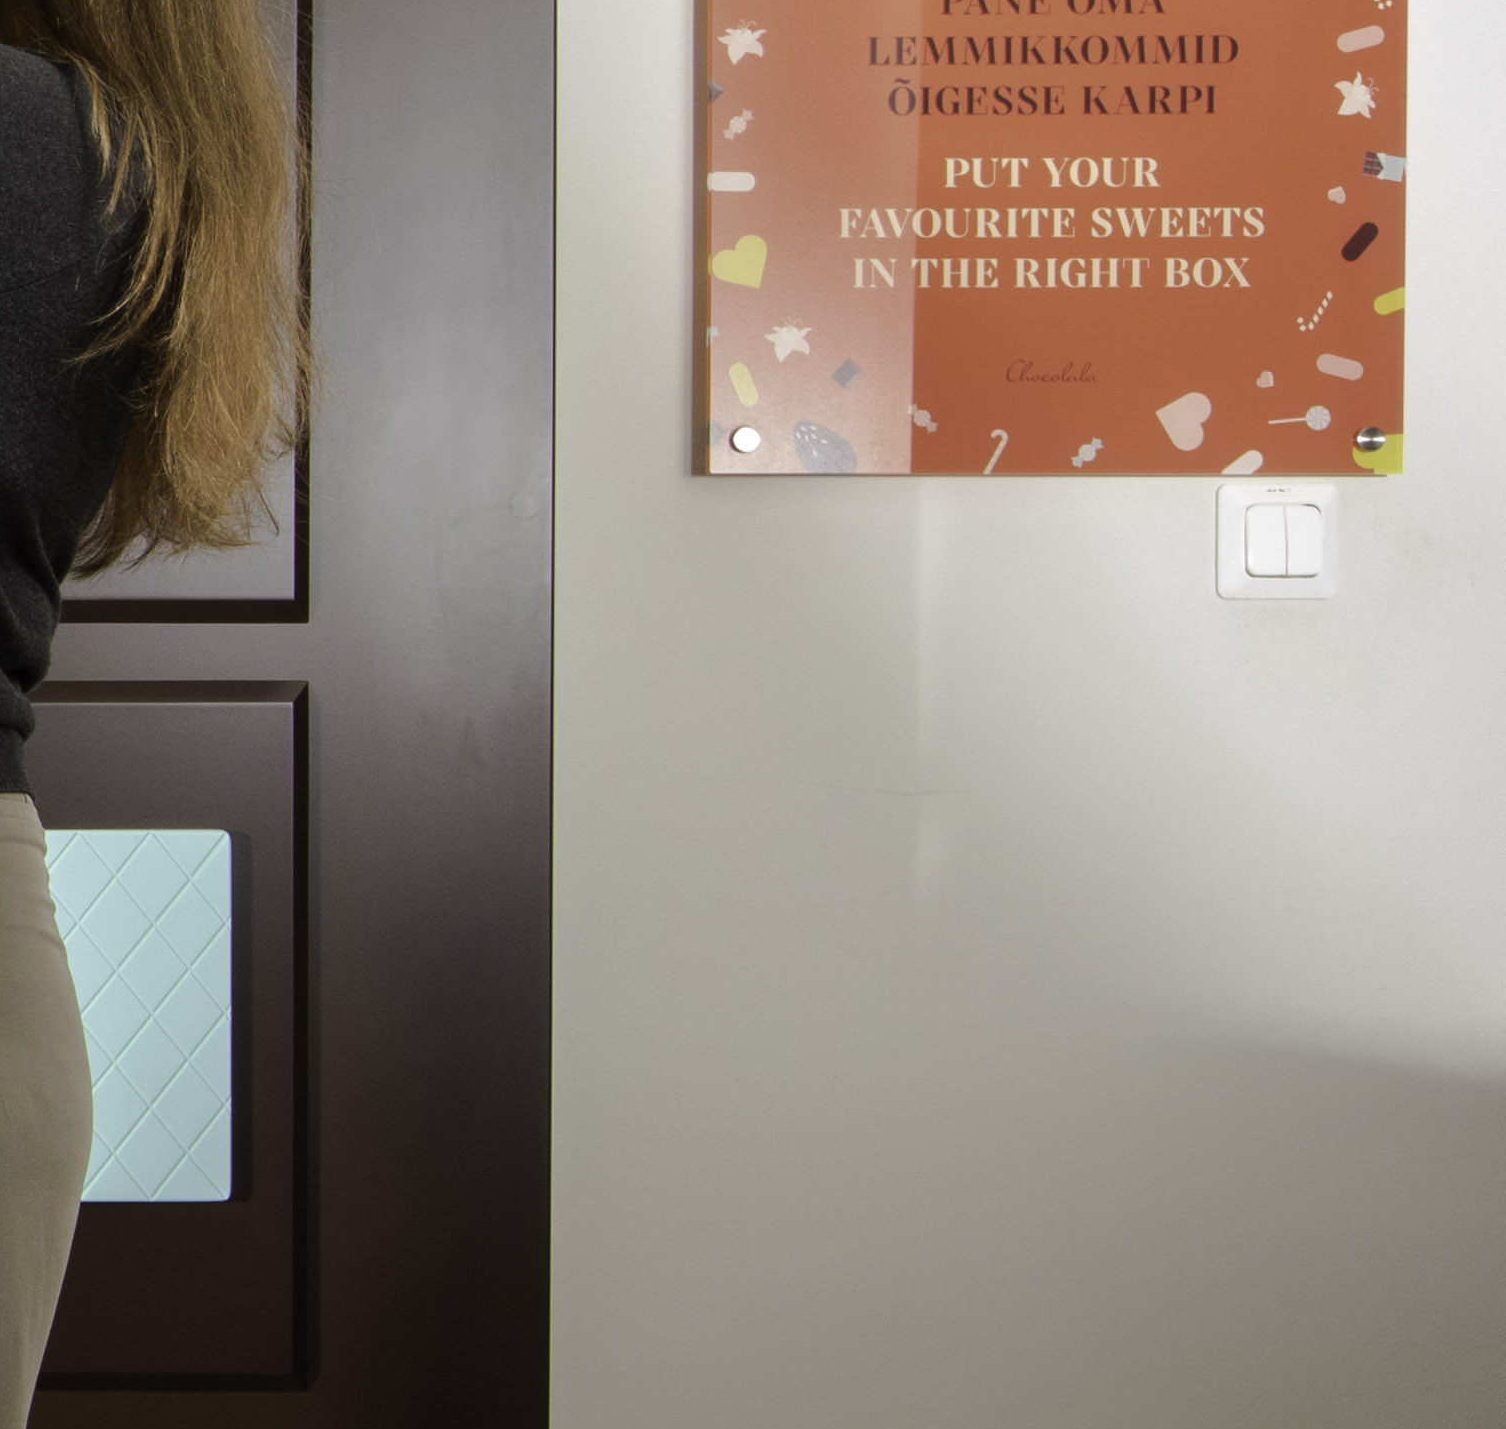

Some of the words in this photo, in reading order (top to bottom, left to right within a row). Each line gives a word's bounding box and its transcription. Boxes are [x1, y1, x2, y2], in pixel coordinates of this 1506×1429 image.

[868, 35, 1240, 66] LEMMIKKOMMID
[887, 78, 1066, 116] ÕIGESSE
[1082, 86, 1217, 116] KARPI
[944, 158, 1030, 189] PUT
[1042, 157, 1162, 189] YOUR
[839, 208, 1077, 239] FAVOURITE
[1091, 207, 1267, 239] SWEETS
[853, 259, 898, 289] IN
[910, 258, 1000, 289] THE
[1014, 258, 1151, 289] RIGHT
[1164, 258, 1252, 289] BOX
[1005, 358, 1097, 383] Chocolala
